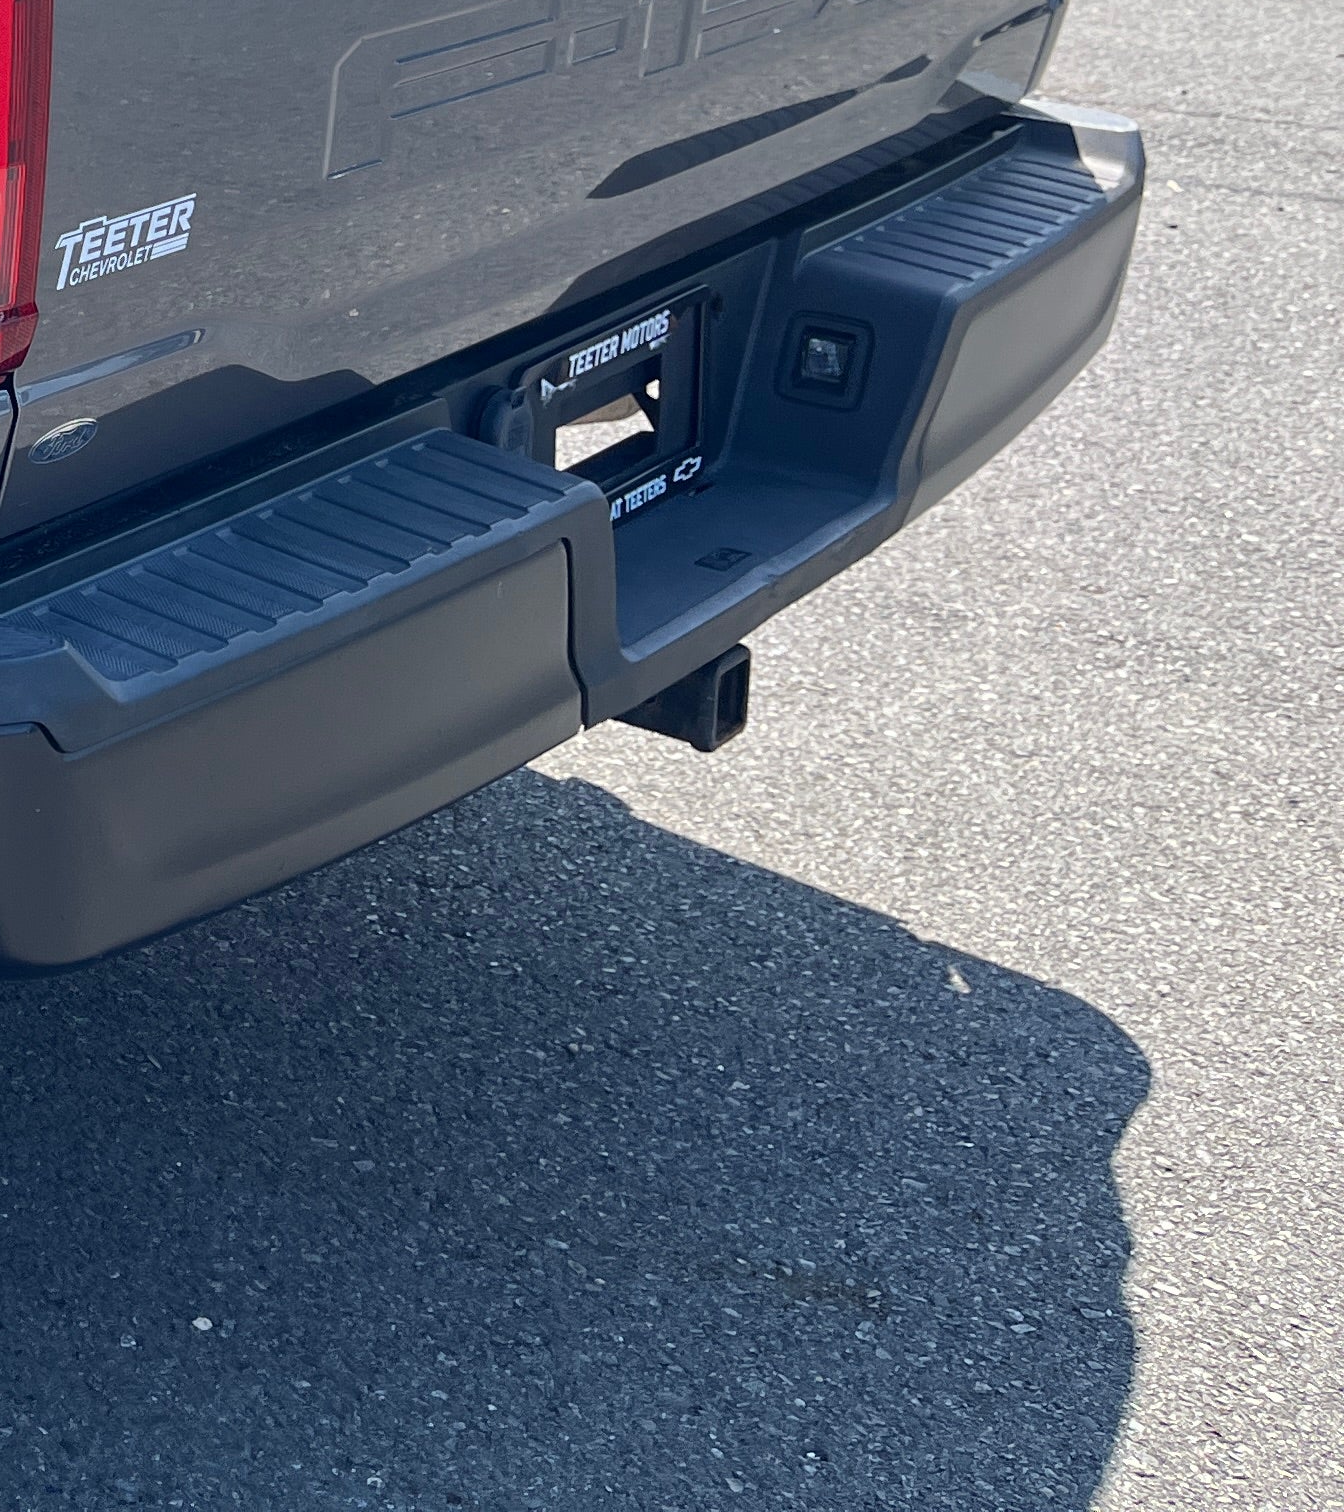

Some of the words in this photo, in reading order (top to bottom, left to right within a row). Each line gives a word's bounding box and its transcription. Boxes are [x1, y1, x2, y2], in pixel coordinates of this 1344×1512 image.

[56, 200, 195, 291] TEETER
[69, 244, 154, 287] CHEVROLET
[568, 335, 618, 377] TEETER
[620, 309, 671, 356] MOTORS
[625, 474, 667, 514] TEETERS
